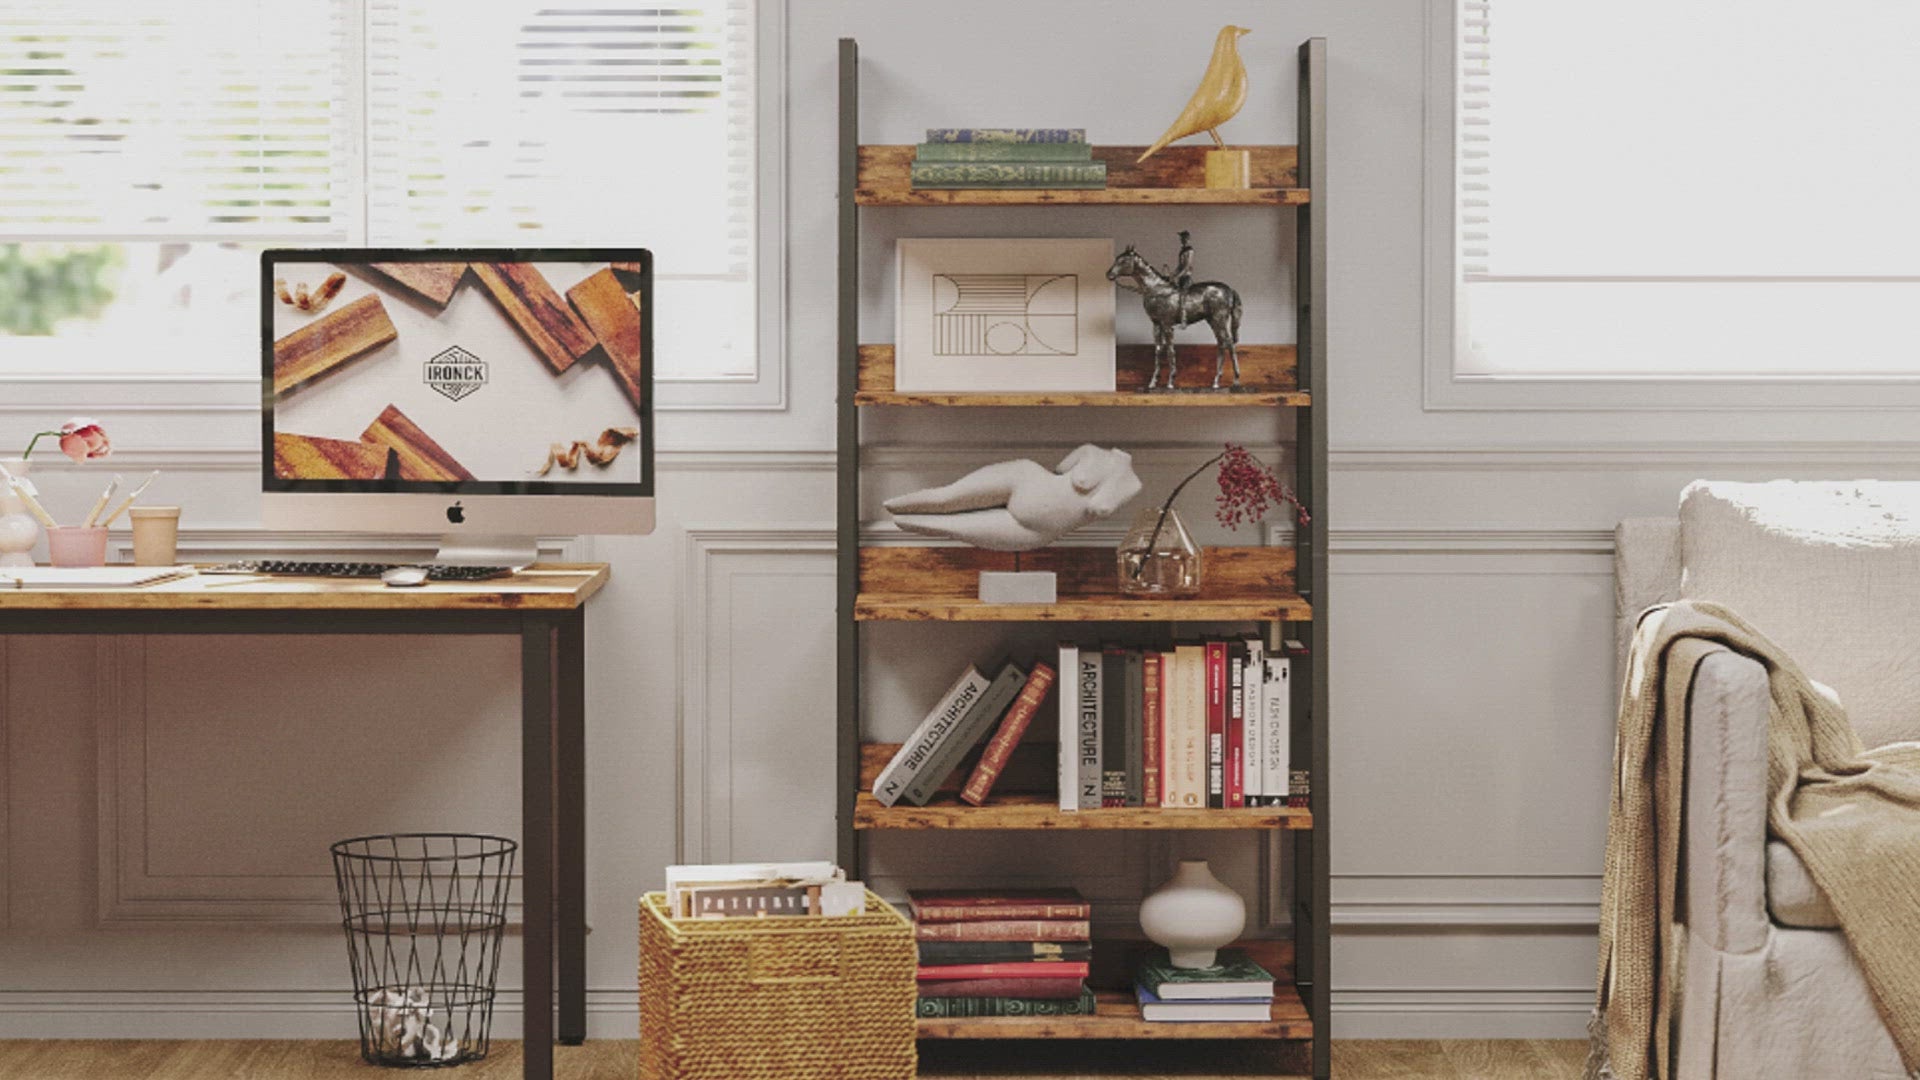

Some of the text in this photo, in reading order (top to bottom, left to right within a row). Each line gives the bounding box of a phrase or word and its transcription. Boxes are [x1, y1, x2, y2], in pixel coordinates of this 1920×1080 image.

[428, 365, 484, 380] IRONCK
[904, 682, 978, 771] ARCHITECTURE
[1081, 662, 1097, 766] ARCHITECTURE
